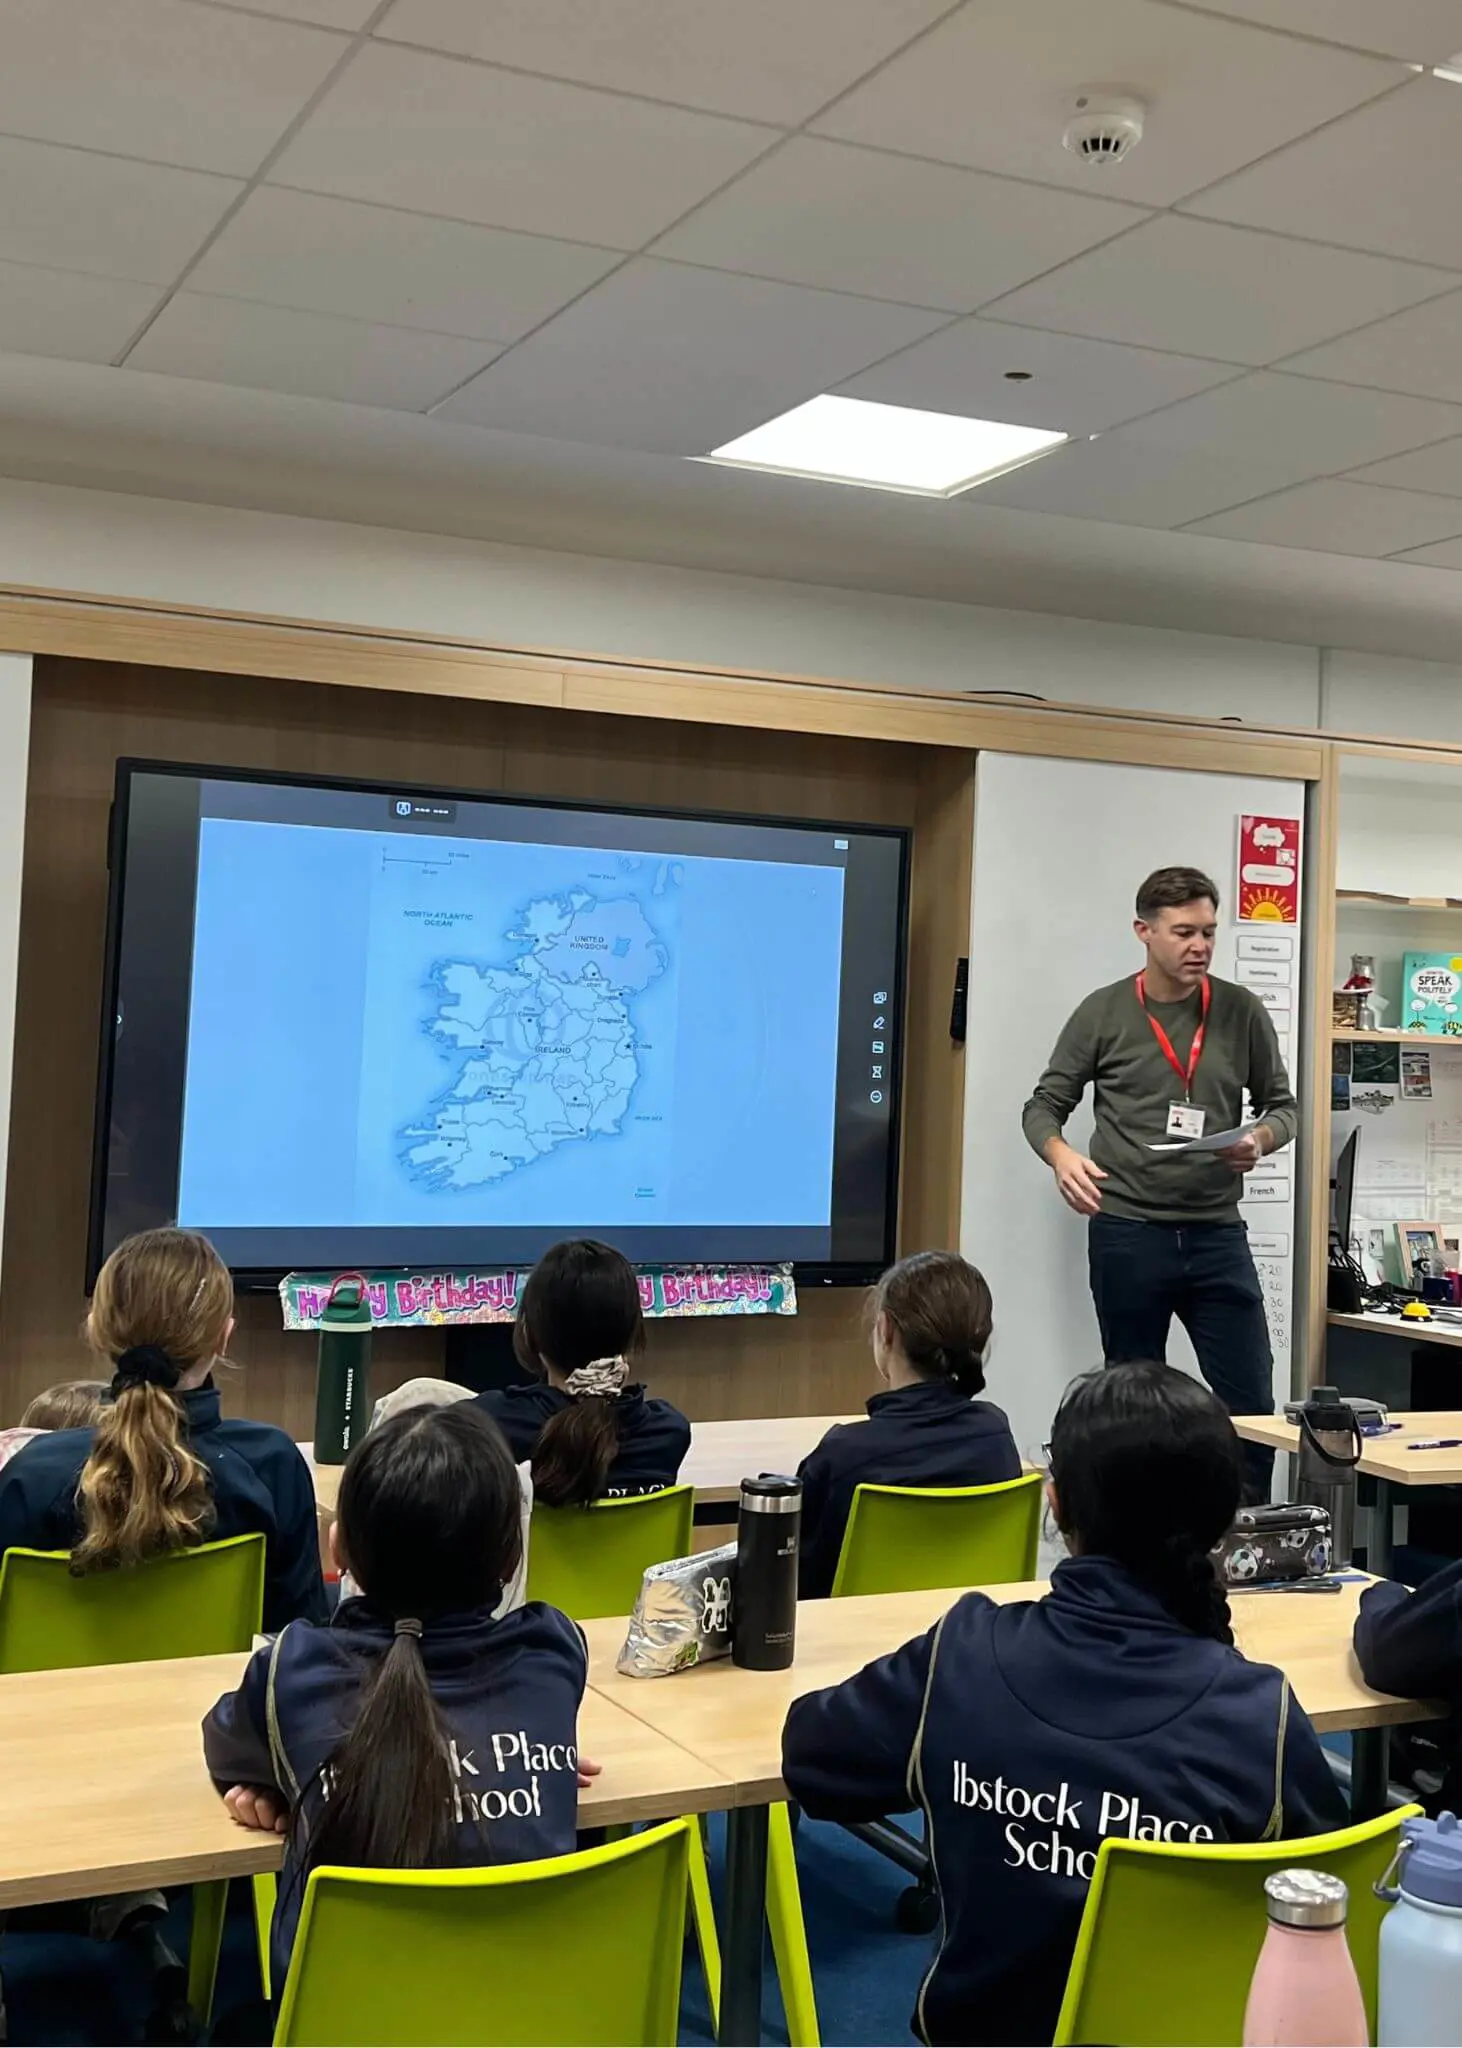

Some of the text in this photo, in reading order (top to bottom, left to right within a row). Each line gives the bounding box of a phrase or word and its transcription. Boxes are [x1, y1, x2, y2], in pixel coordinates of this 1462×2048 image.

[424, 919, 453, 927] OCEAN
[570, 942, 609, 950] KINGDOM
[1418, 975, 1453, 986] SPEAK
[1417, 986, 1452, 994] POLITELY
[535, 1046, 571, 1054] IRELAND
[1250, 1186, 1275, 1195] French
[660, 1269, 772, 1307] Birthday!
[396, 1271, 517, 1317] Birthday!
[953, 1759, 1214, 1844] Ibstock Place
[1003, 1822, 1098, 1881] Scho
